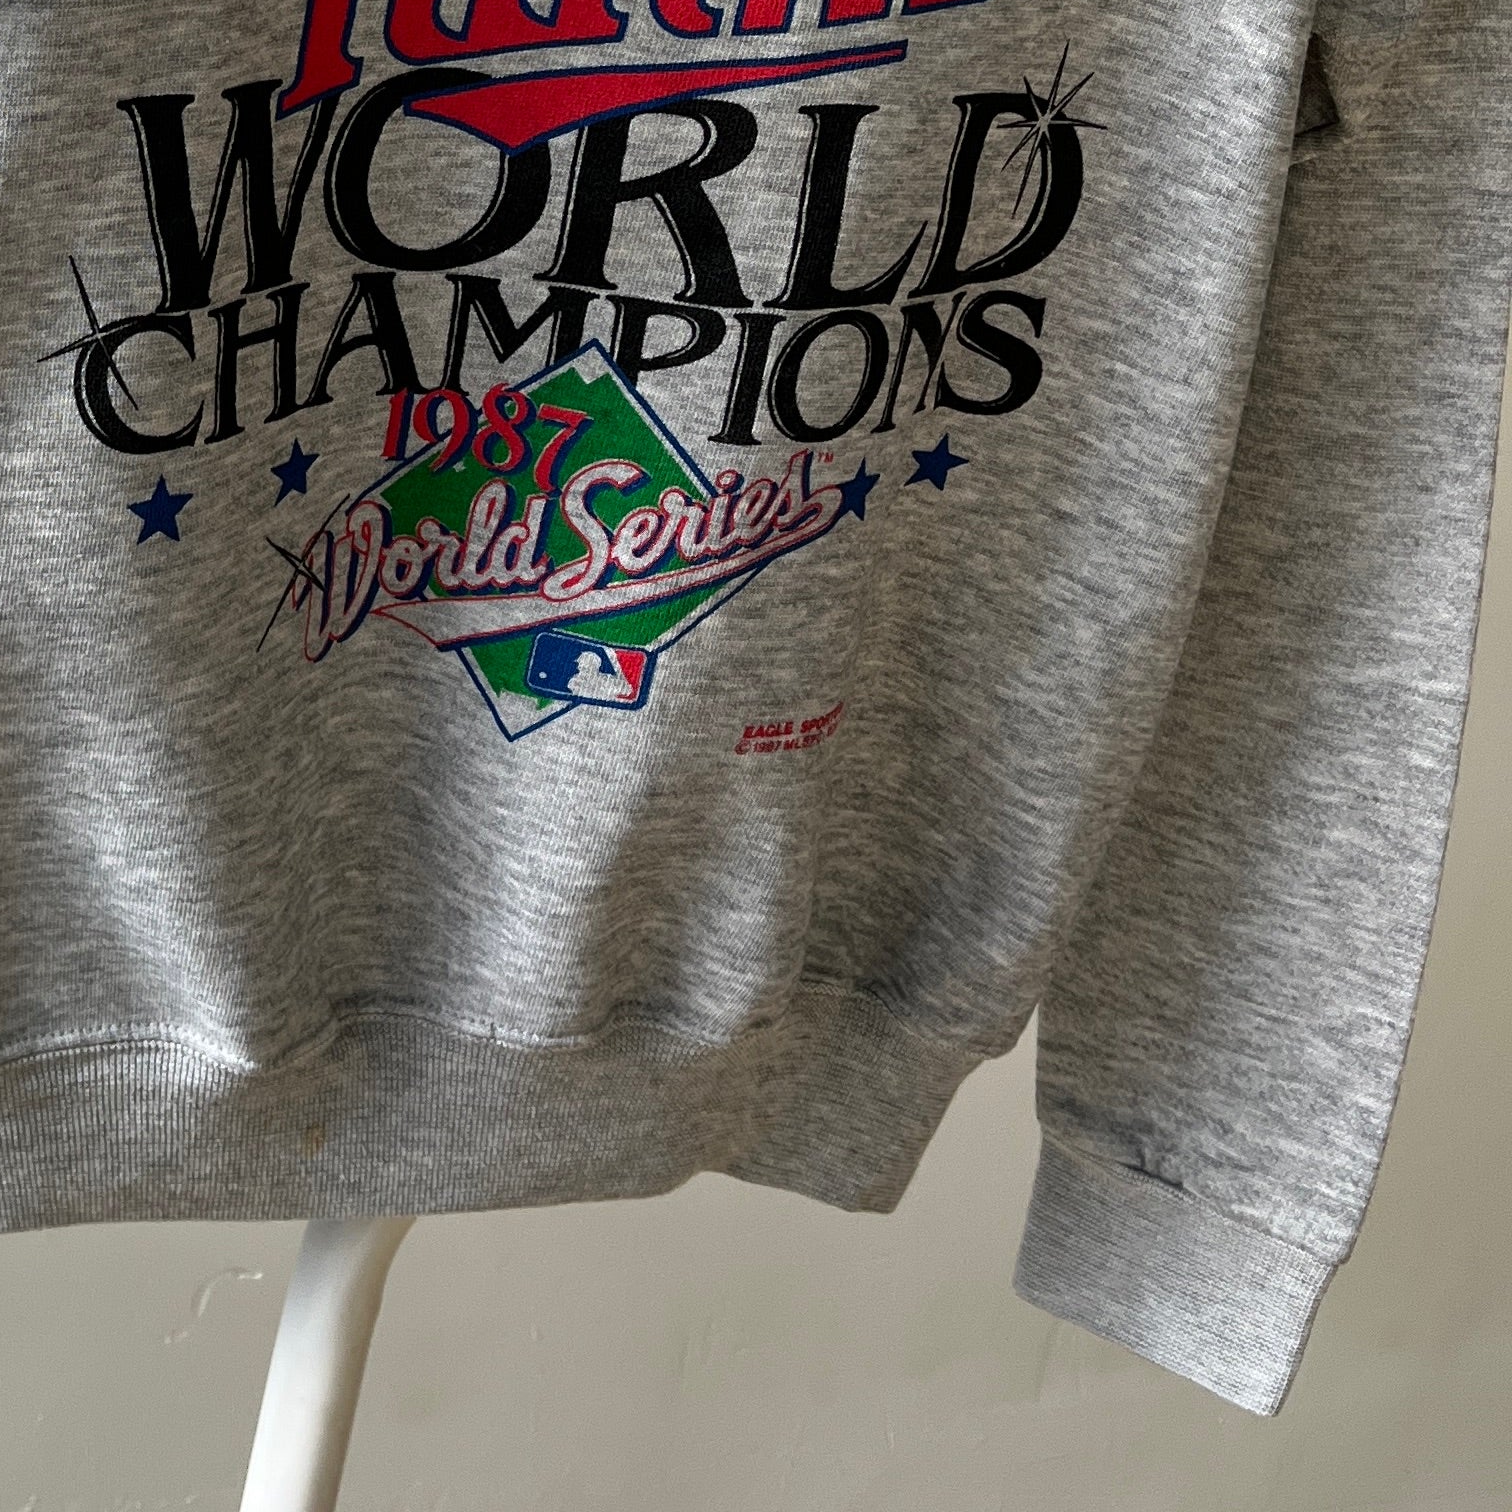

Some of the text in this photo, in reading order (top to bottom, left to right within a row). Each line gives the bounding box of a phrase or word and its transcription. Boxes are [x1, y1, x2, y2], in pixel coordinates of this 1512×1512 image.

[115, 67, 1085, 315] WORLD
[73, 273, 1047, 455] CHAMPIONS
[380, 382, 596, 499] 1987
[291, 477, 558, 664] World
[539, 448, 844, 603] Series
[742, 719, 794, 740] EAGLE
